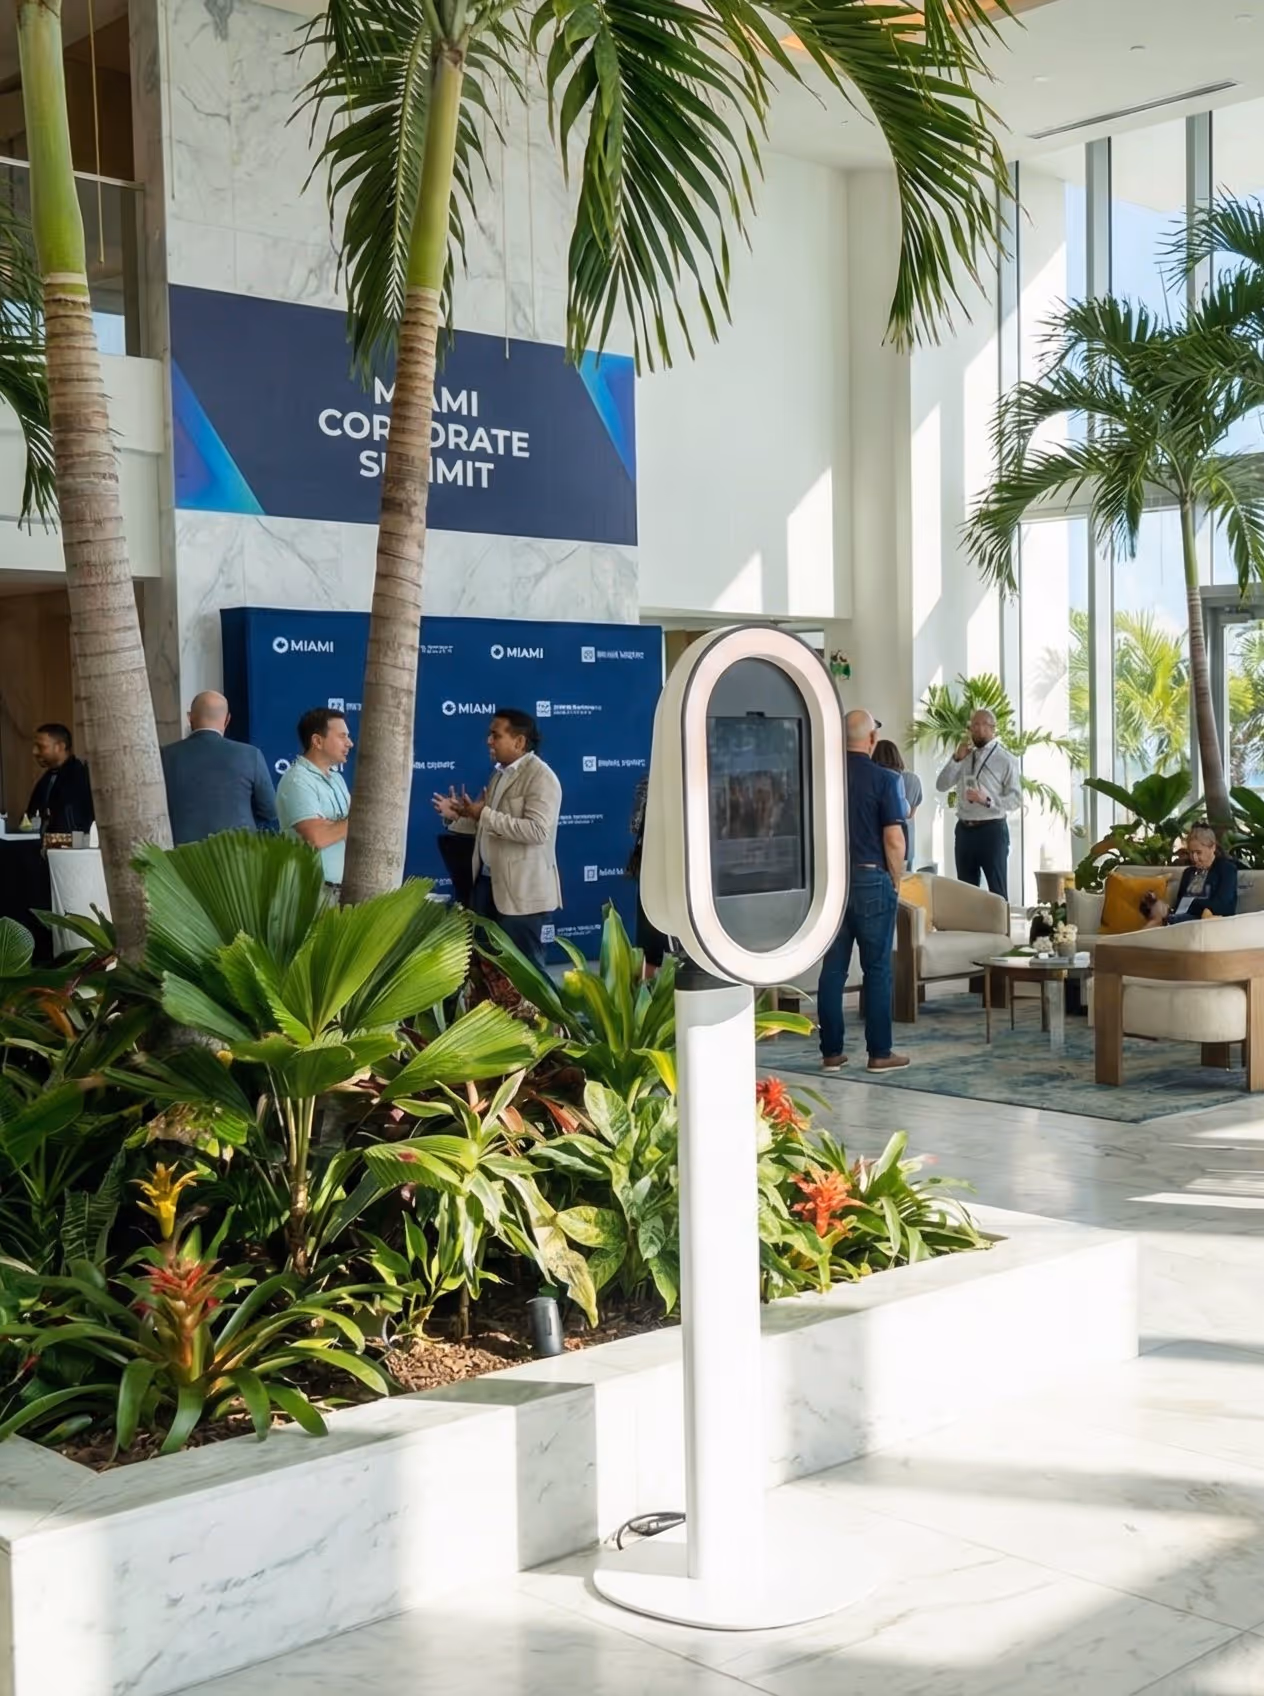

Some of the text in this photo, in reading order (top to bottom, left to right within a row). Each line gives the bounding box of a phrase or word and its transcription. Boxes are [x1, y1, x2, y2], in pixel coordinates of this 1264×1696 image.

[318, 408, 530, 458] CORORATE
[290, 639, 334, 653] MIAMI
[506, 647, 544, 659] MIAMI
[458, 703, 496, 715] MIAMI
